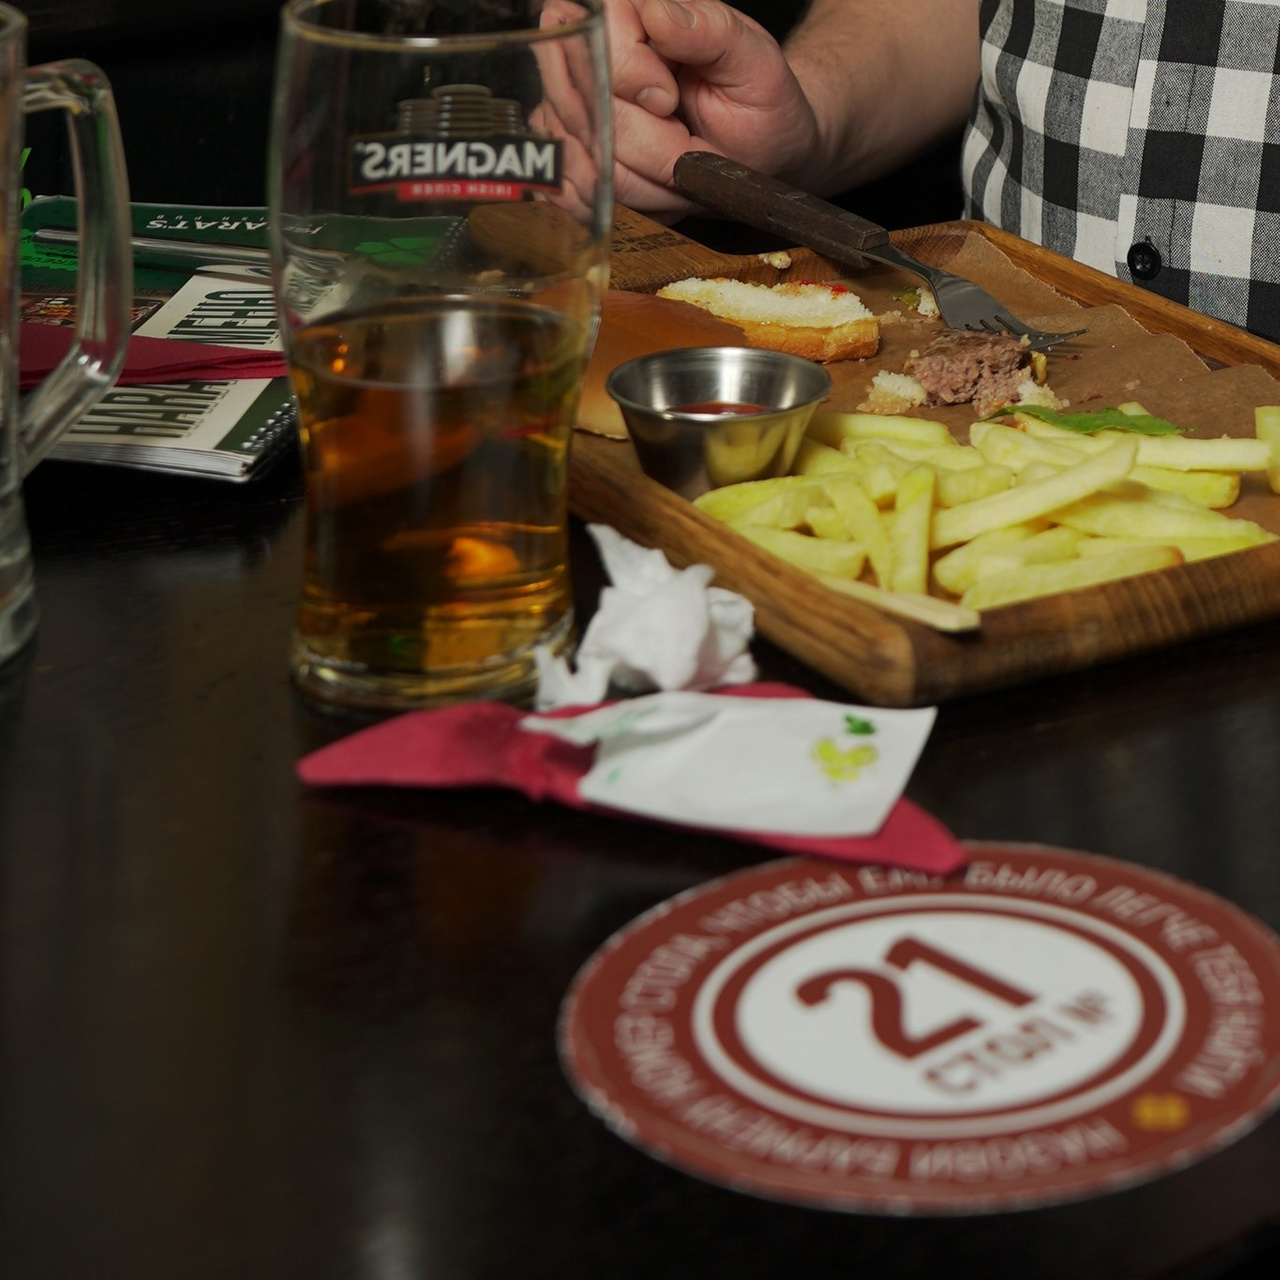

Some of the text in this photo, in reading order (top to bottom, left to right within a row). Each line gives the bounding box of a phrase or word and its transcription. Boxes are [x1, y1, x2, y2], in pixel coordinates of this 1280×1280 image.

[962, 860, 1097, 905] БЫЛО
[1089, 885, 1220, 954] ЛЕГЧЕ
[797, 934, 1037, 1060] 21
[924, 1018, 1076, 1095] СТОЛ
[908, 1116, 1129, 1182] НАЗОВИ
